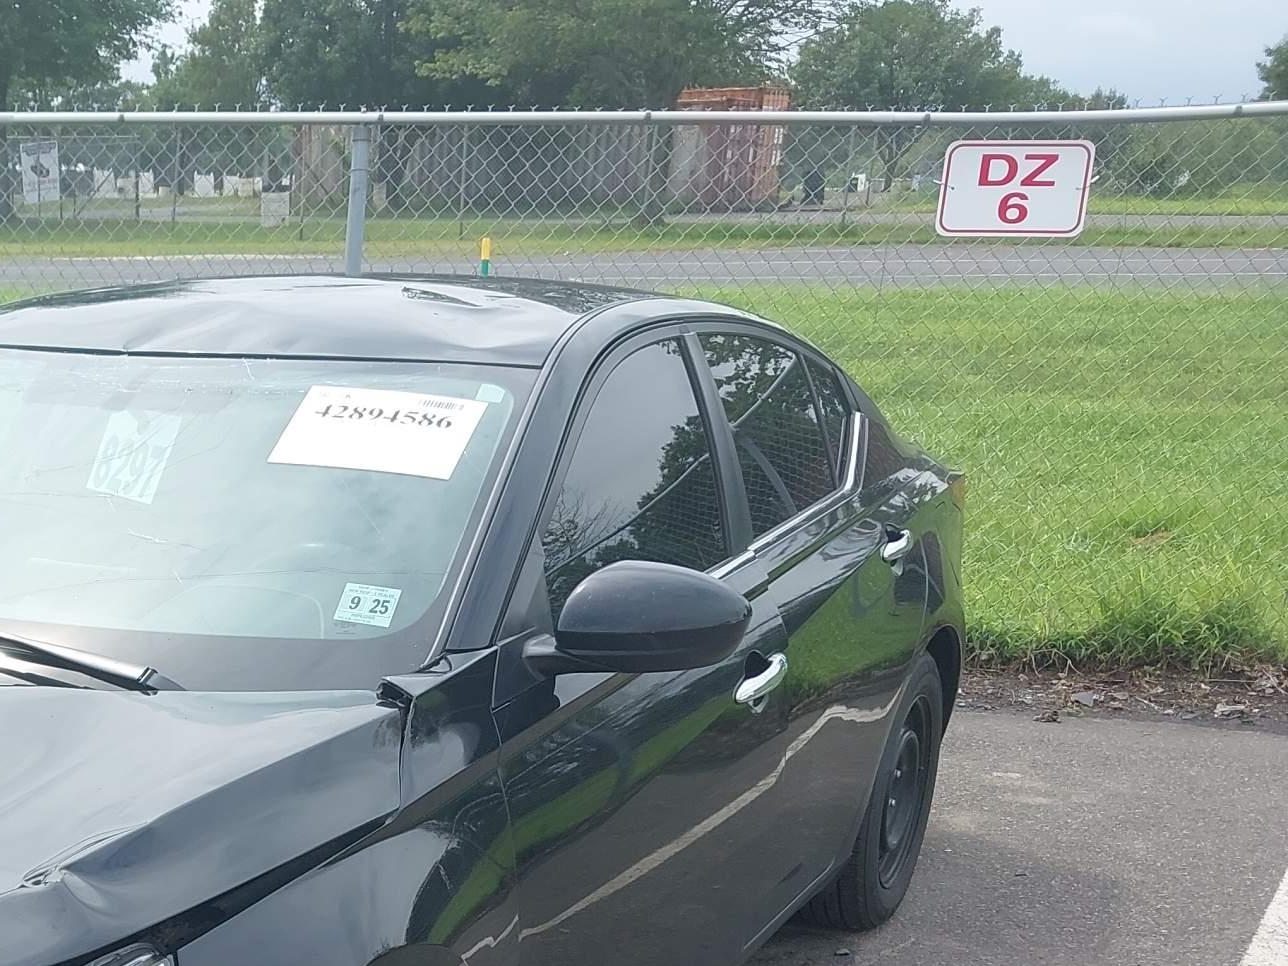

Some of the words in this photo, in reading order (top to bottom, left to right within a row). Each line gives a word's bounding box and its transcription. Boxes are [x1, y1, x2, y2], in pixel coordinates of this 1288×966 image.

[978, 154, 1059, 186] DZ
[998, 192, 1029, 224] 6
[314, 403, 453, 429] 42894586
[349, 596, 361, 610] 9
[369, 598, 391, 614] 25
